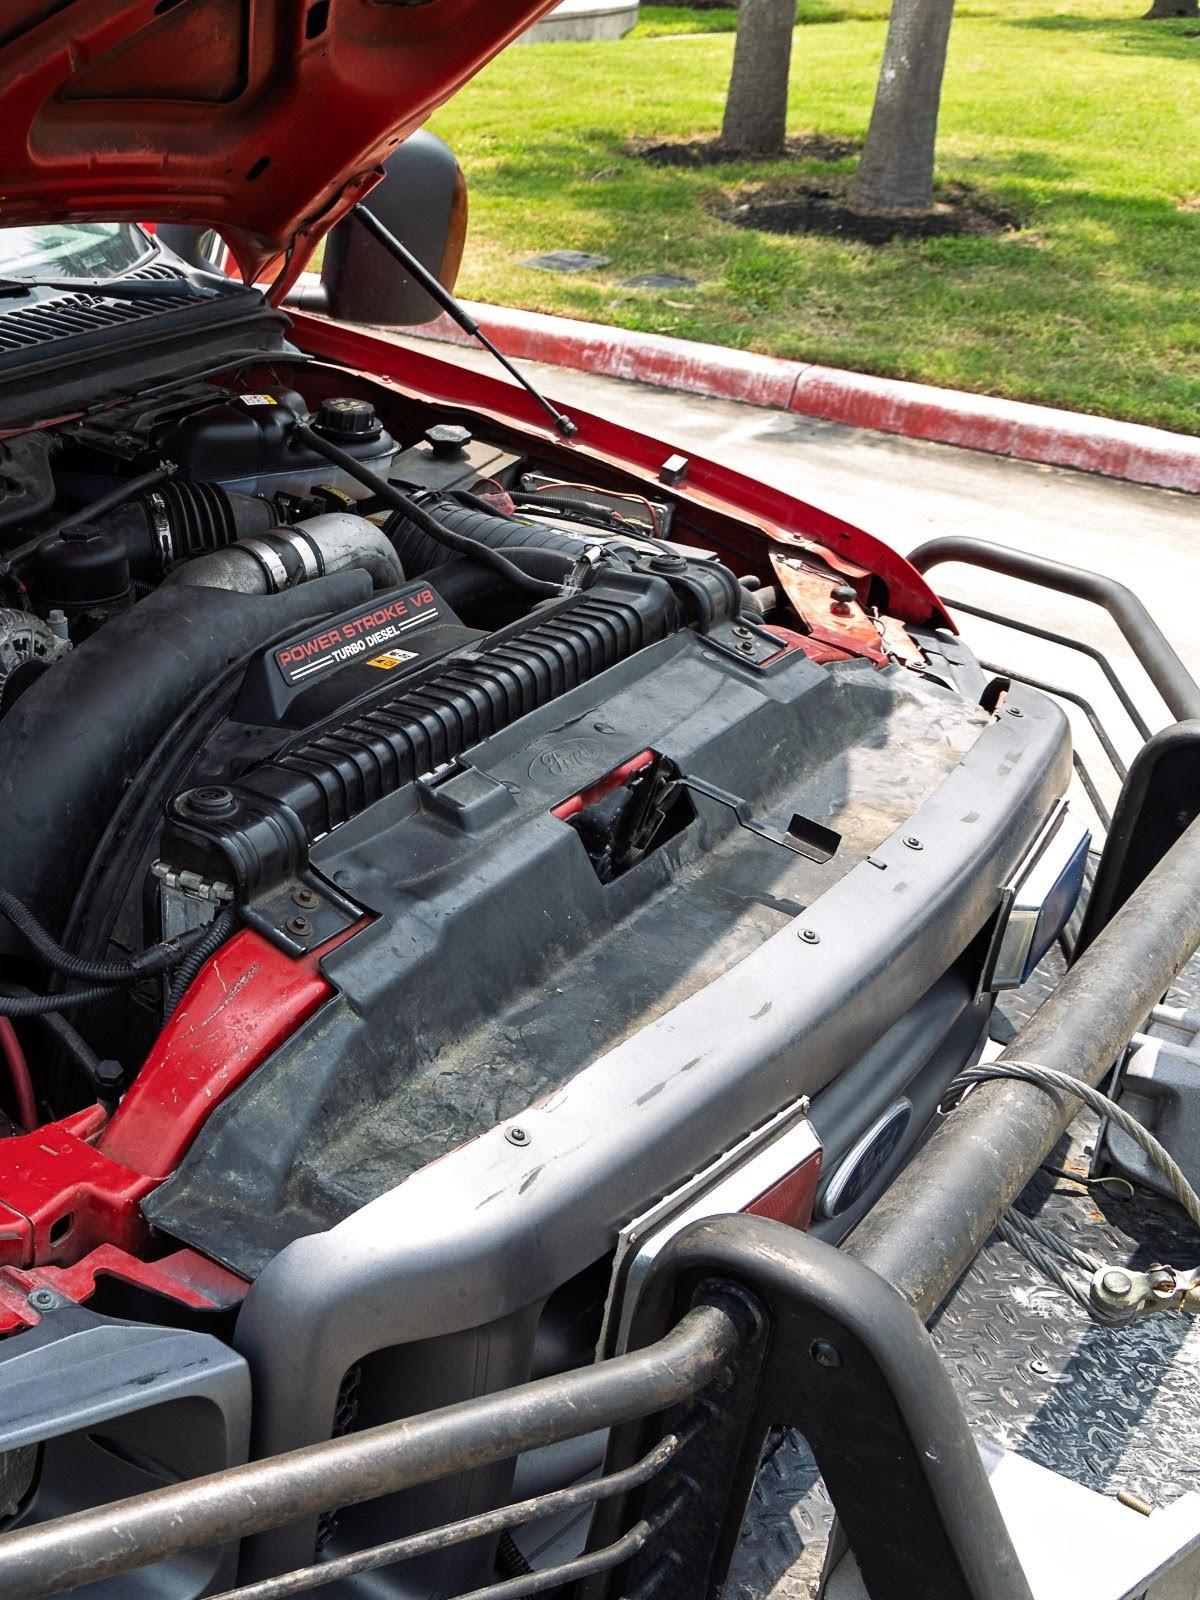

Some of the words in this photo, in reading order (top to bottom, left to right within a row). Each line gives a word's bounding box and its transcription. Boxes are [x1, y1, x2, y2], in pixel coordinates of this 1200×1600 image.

[278, 630, 342, 667] POWER
[343, 601, 408, 639] STROKE
[410, 588, 434, 609] V8
[331, 639, 366, 662] TURBO
[366, 624, 401, 648] DIESEL
[540, 743, 595, 777] Ford
